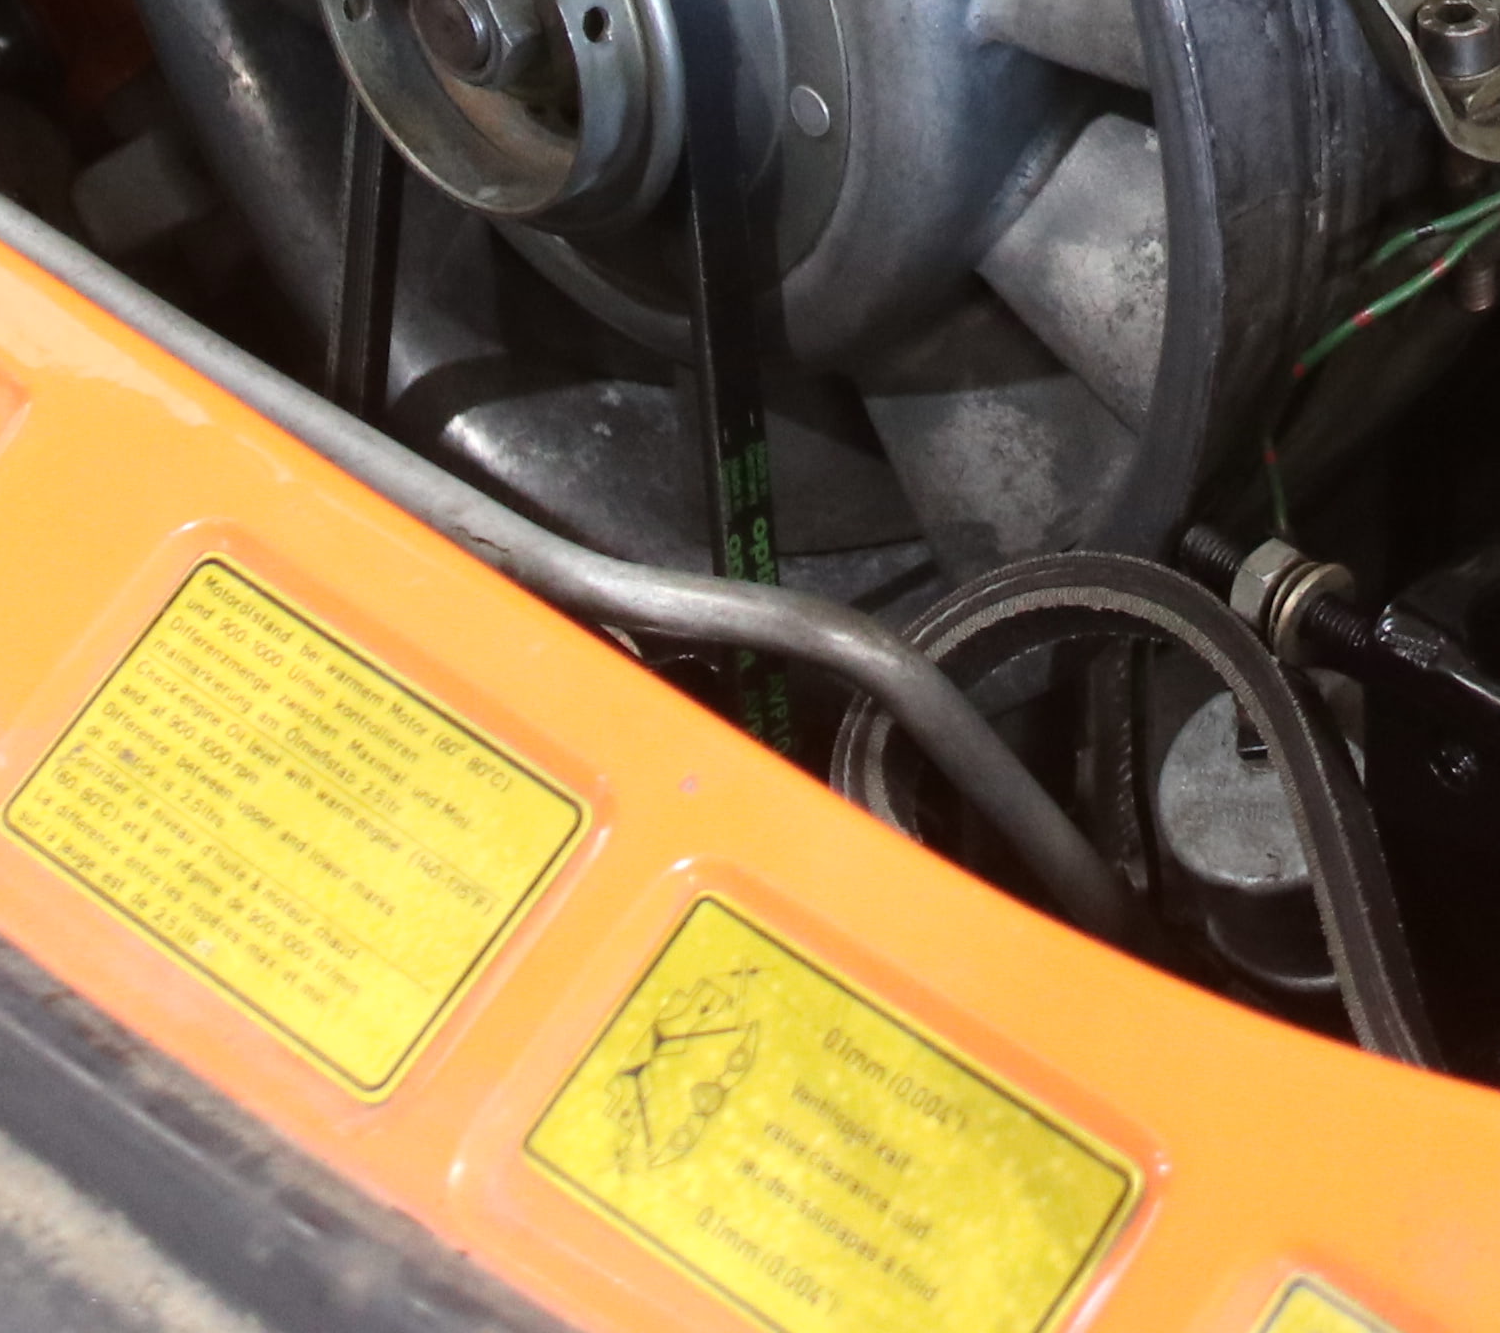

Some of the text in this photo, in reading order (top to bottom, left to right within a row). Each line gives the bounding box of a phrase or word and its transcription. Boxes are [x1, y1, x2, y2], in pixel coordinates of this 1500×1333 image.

[119, 680, 148, 705] and
[149, 702, 166, 718] at
[230, 761, 260, 787] rpm
[167, 615, 274, 694] Differenzmenge
[346, 738, 408, 786] Maximal
[185, 596, 214, 620] und
[333, 698, 420, 762] kontrollieren
[201, 575, 294, 643] Motorölstand
[386, 702, 430, 737] Motor
[257, 711, 280, 730] am
[85, 723, 104, 740] on
[106, 737, 158, 779] ditick
[101, 700, 173, 756] Difference
[176, 754, 235, 800] between
[279, 828, 308, 853] and
[135, 659, 181, 696] Check
[177, 692, 223, 728] engine
[225, 721, 247, 742] Oil
[247, 739, 282, 767] level
[284, 764, 315, 790] with
[315, 788, 355, 820] warm
